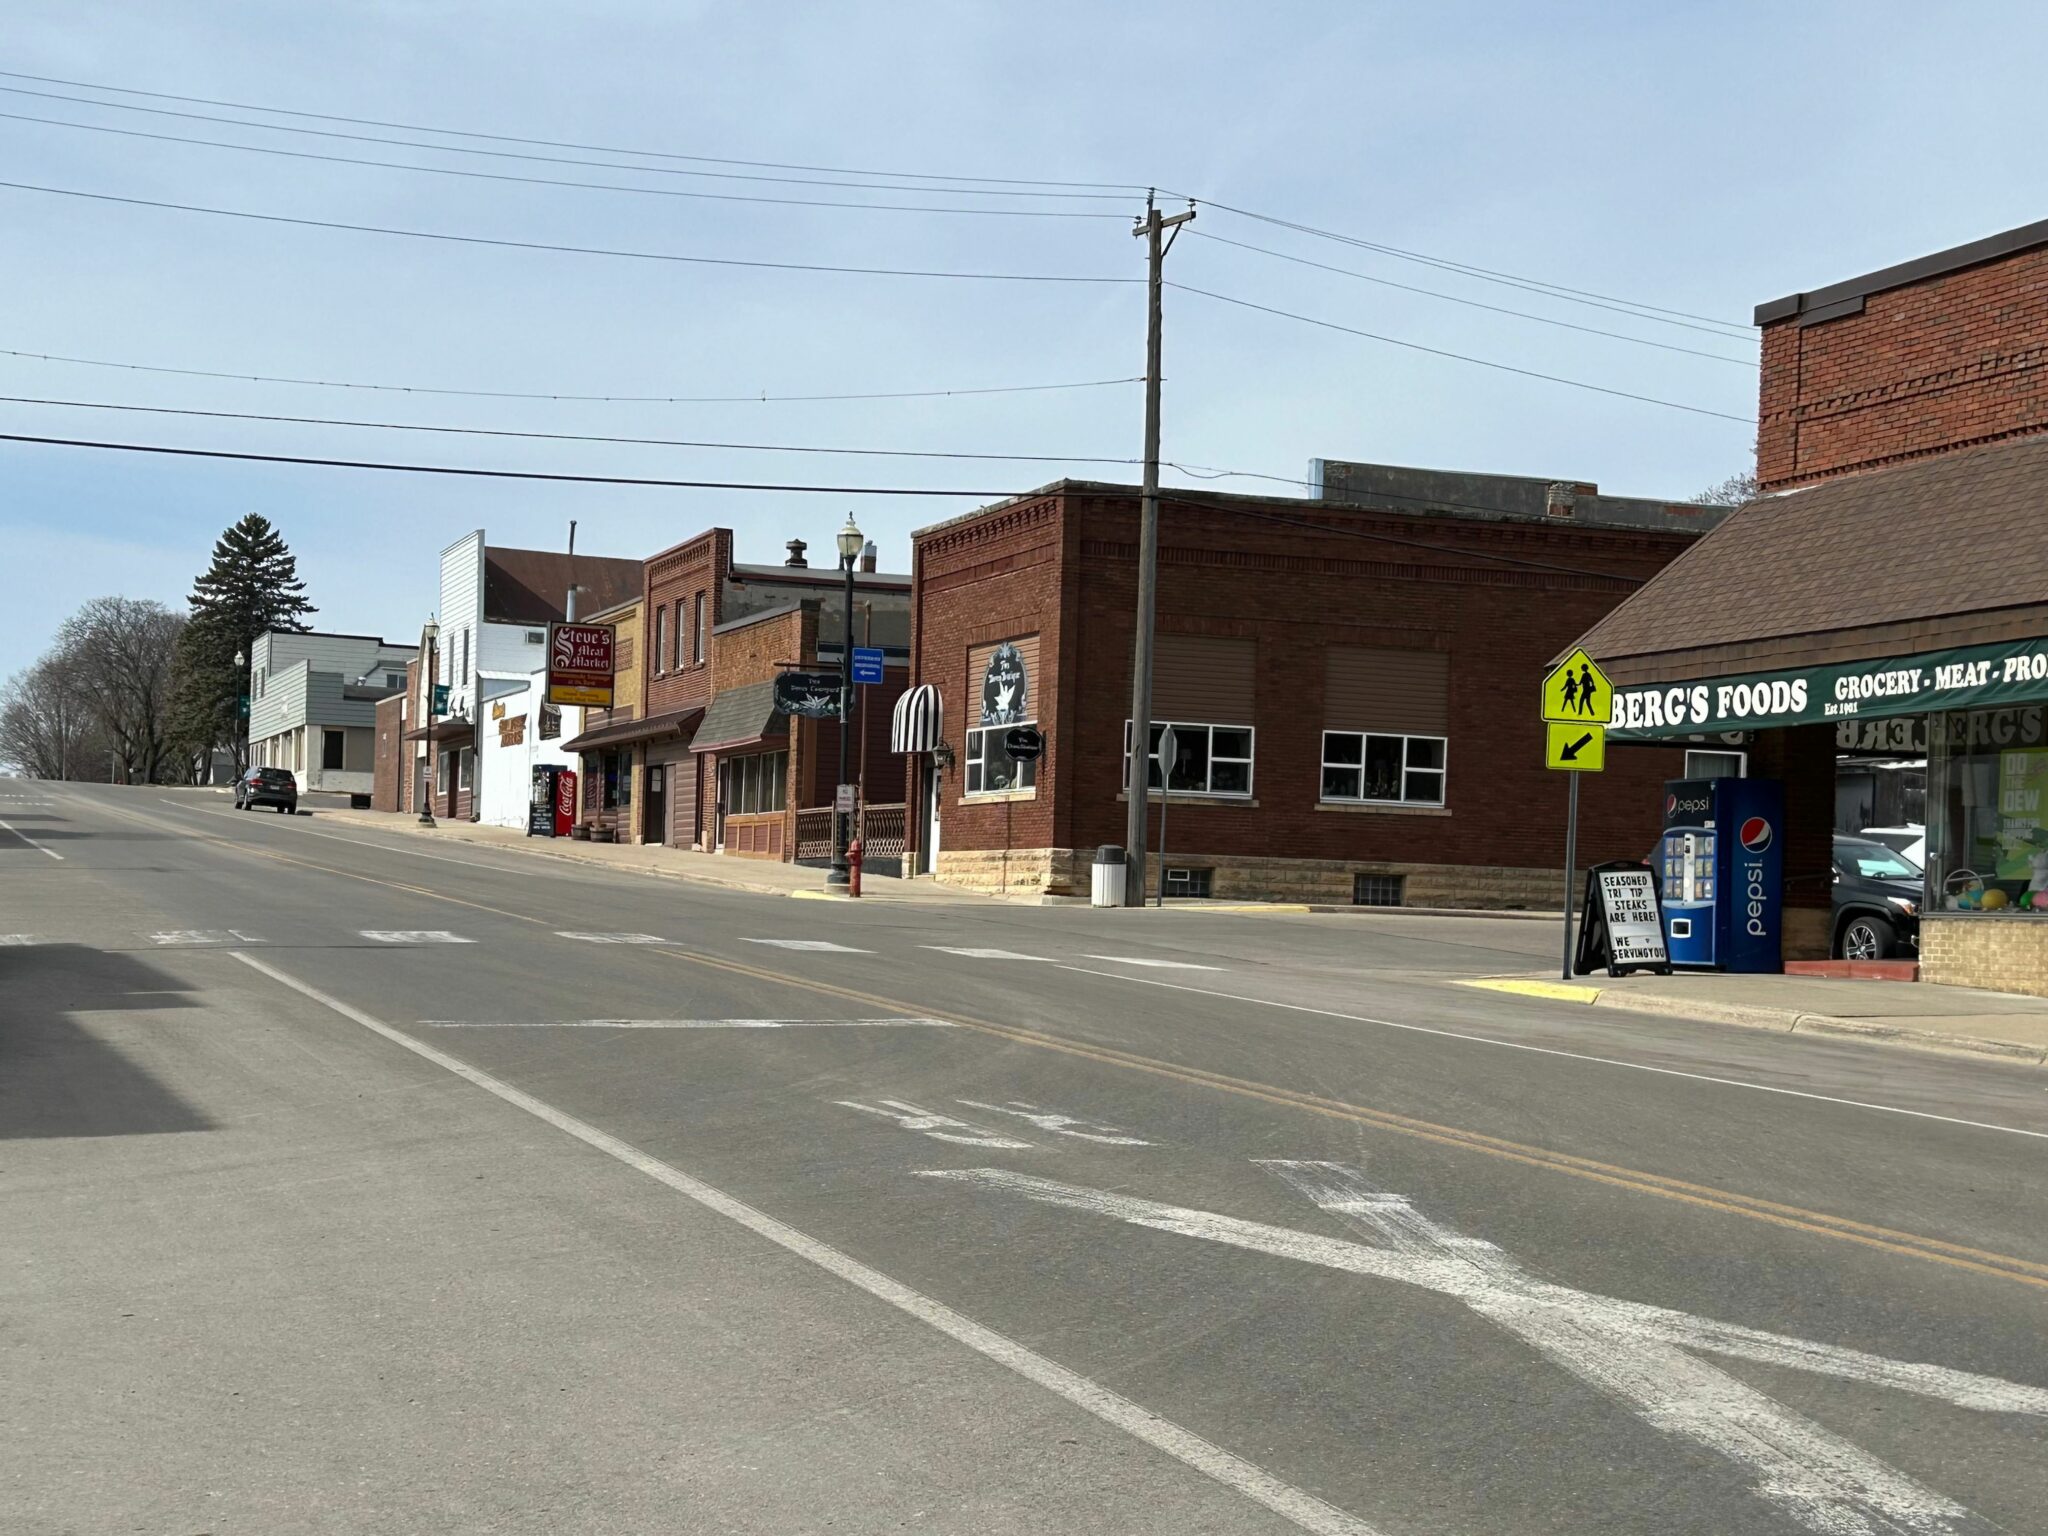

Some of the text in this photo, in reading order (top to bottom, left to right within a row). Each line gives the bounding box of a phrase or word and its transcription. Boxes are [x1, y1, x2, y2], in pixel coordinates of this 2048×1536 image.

[555, 628, 610, 668] Steve's
[577, 645, 604, 657] Meat
[571, 656, 609, 668] Market
[1834, 669, 1922, 701] GROCERY
[1934, 660, 1991, 691] MEAT
[2003, 653, 2048, 683] PRO
[1717, 679, 1808, 718] FOODS
[1677, 796, 1710, 814] pepsi
[2003, 789, 2040, 812] DEW
[1604, 876, 1648, 887] SEASONED
[1607, 888, 1643, 899] TRI TIP
[1744, 863, 1767, 936] pepsi
[1615, 901, 1648, 911] STEAKS
[1609, 912, 1627, 923] ARE
[1616, 937, 1631, 947] WE
